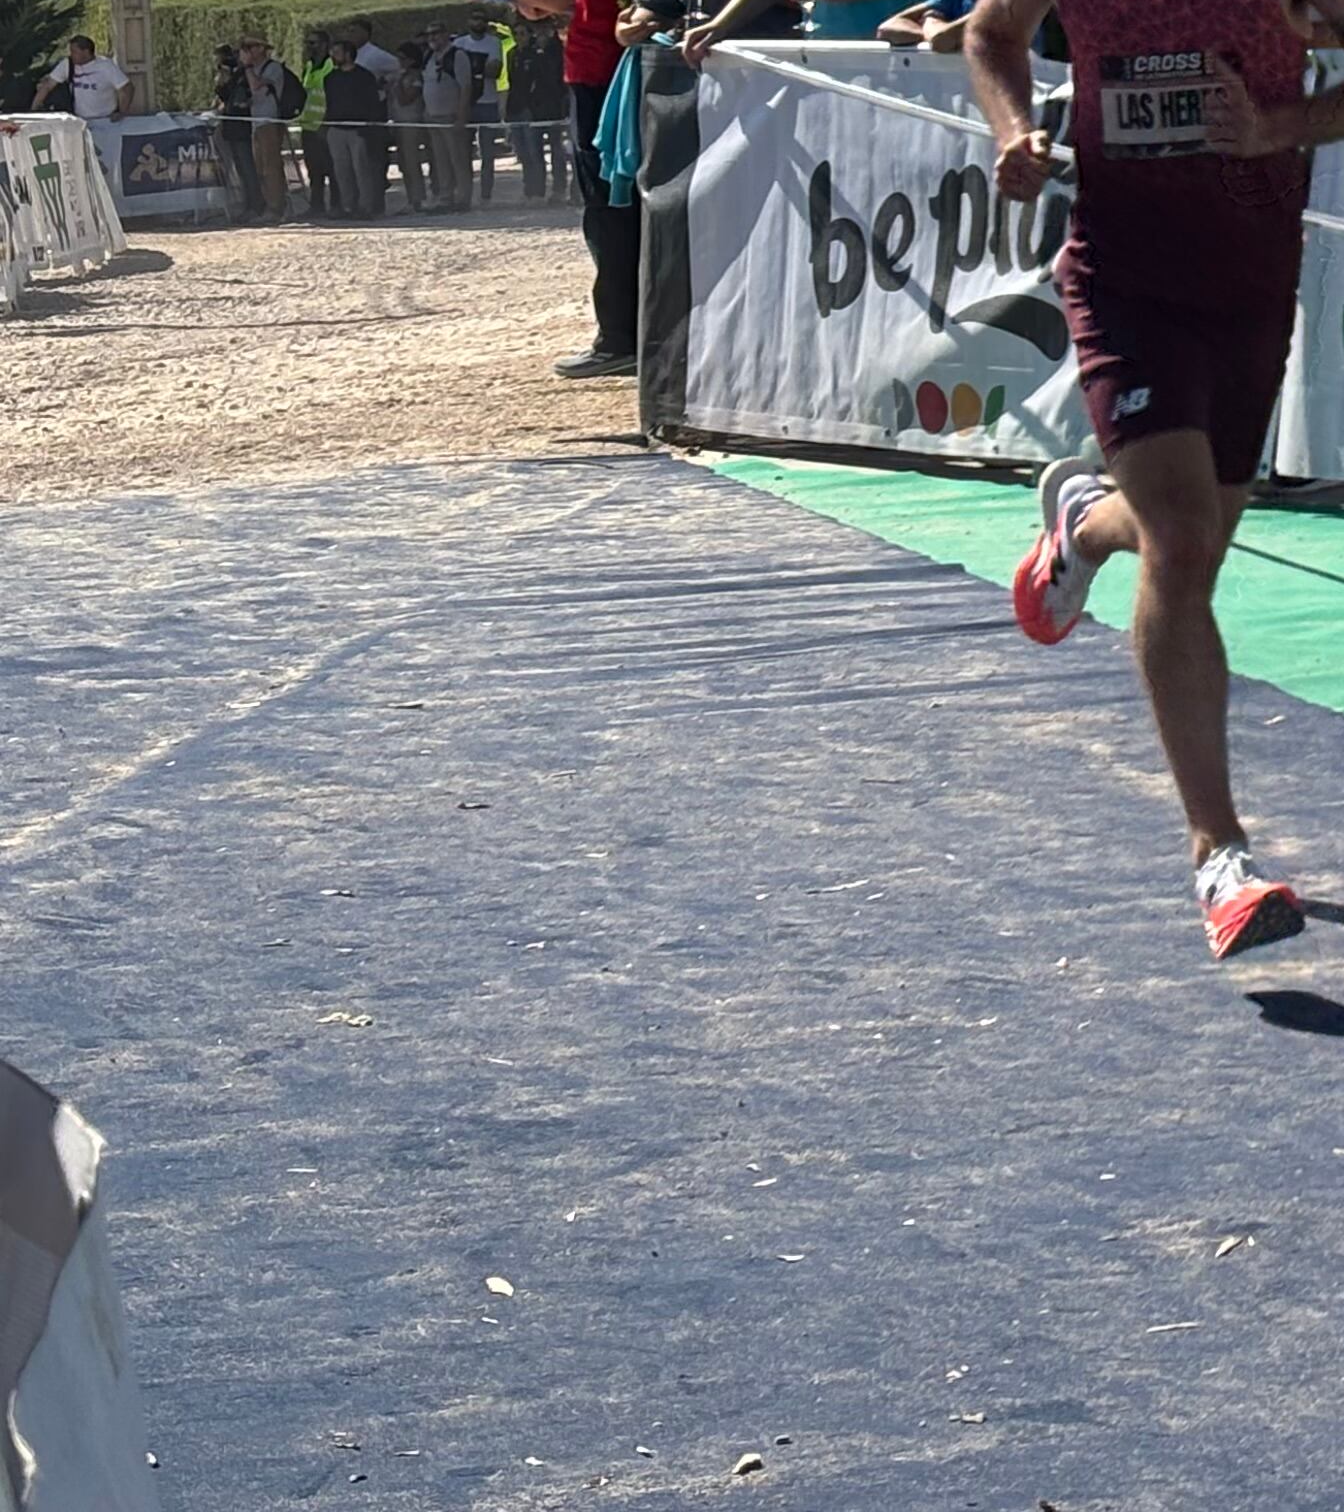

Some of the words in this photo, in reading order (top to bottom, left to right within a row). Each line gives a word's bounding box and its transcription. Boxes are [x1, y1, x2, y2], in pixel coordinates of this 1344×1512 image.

[1133, 52, 1203, 73] CROSS
[1115, 92, 1154, 130] LAS
[808, 160, 917, 319] be
